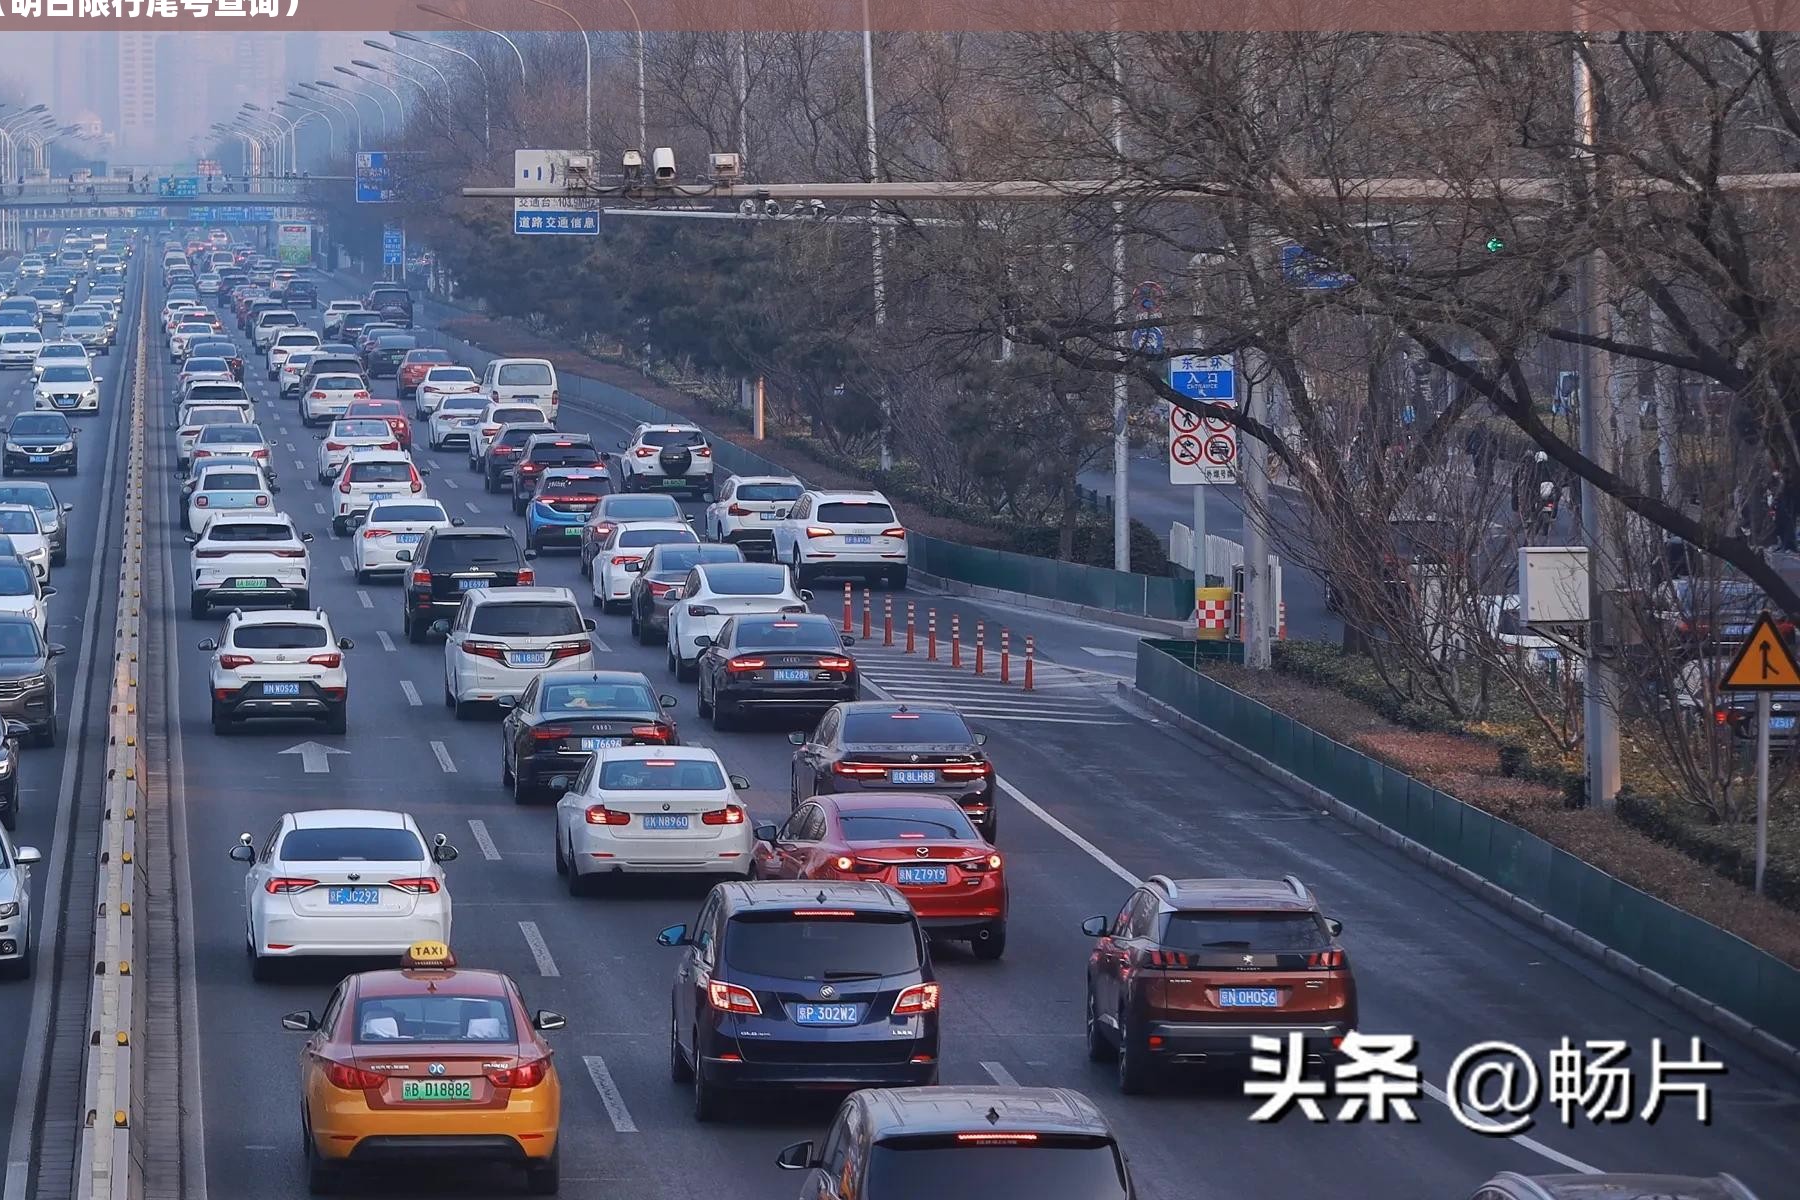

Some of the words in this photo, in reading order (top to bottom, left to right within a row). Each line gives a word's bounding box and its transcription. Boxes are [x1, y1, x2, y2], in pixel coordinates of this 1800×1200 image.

[519, 216, 596, 229] 道路交通信息
[1182, 356, 1222, 370] 东二环
[1187, 372, 1218, 383] 入口
[415, 946, 443, 956] TAXI
